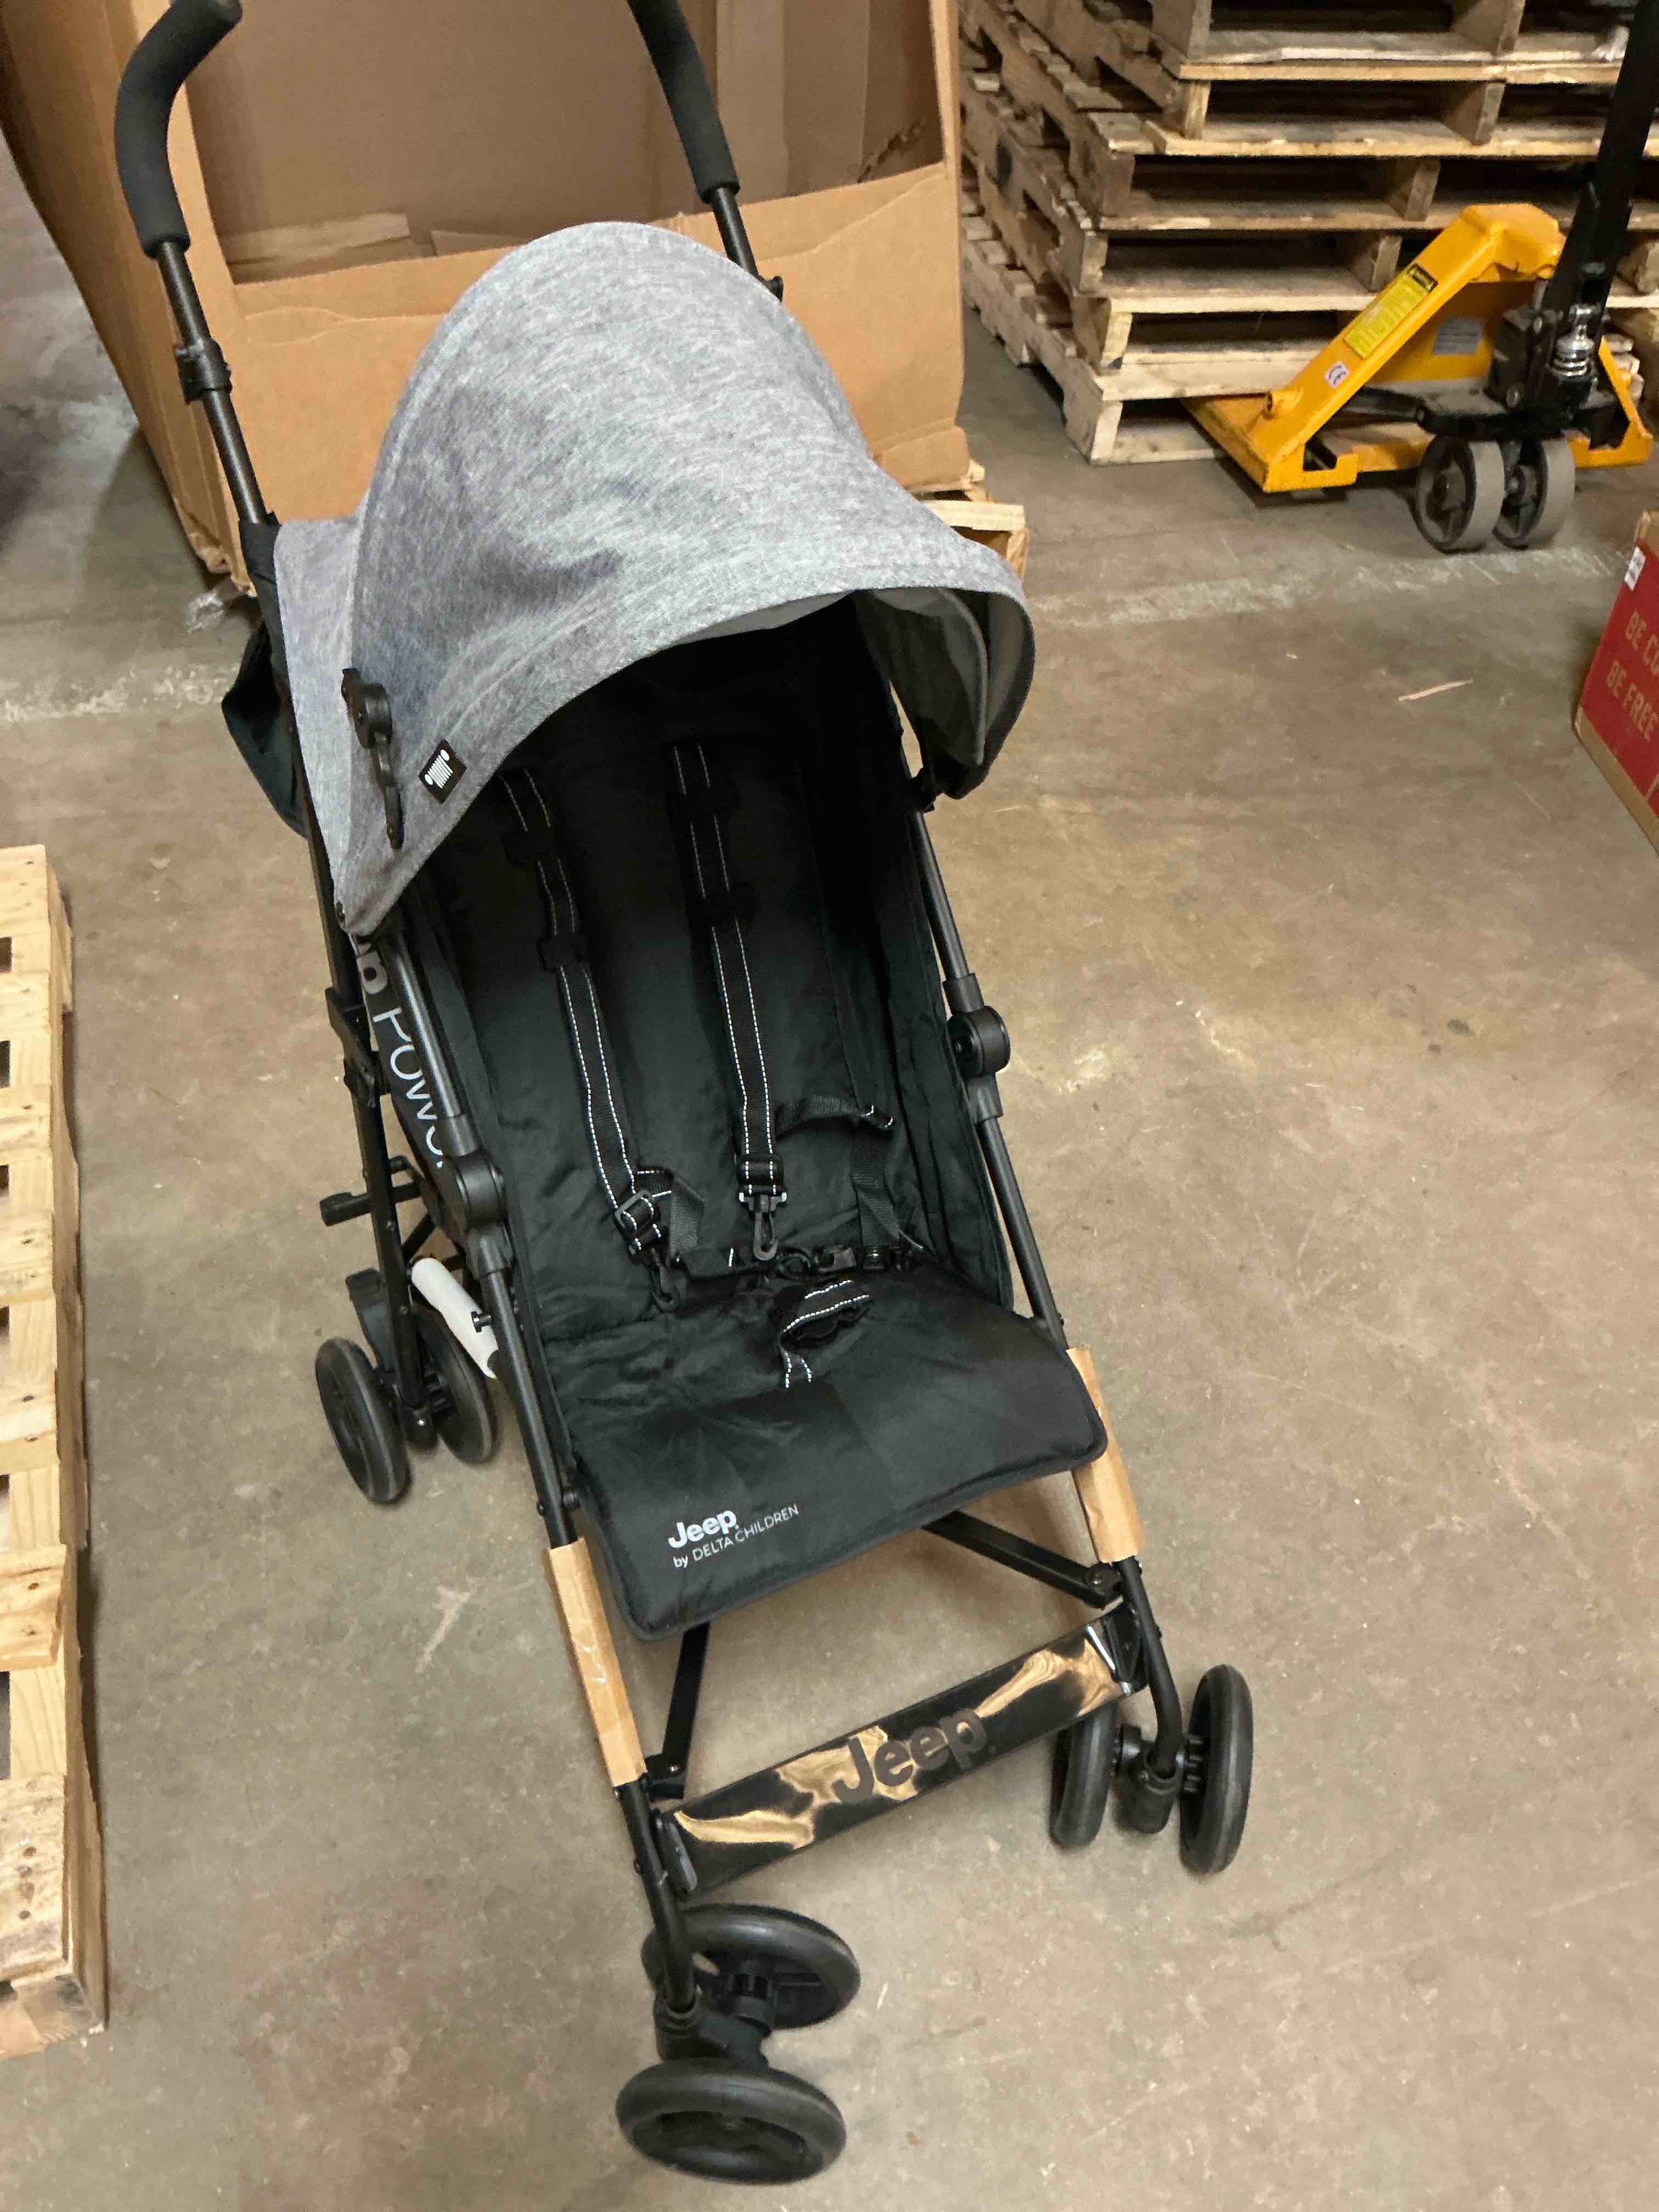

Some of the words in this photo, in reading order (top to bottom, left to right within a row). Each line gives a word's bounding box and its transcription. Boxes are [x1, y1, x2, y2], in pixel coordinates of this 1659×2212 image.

[1622, 681, 1659, 742] FREE
[668, 1510, 737, 1548] Jeep
[673, 1555, 689, 1568] by
[692, 1536, 733, 1561] DELTA
[735, 1503, 799, 1542] CHILDREN
[833, 1708, 988, 1803] Jeep
